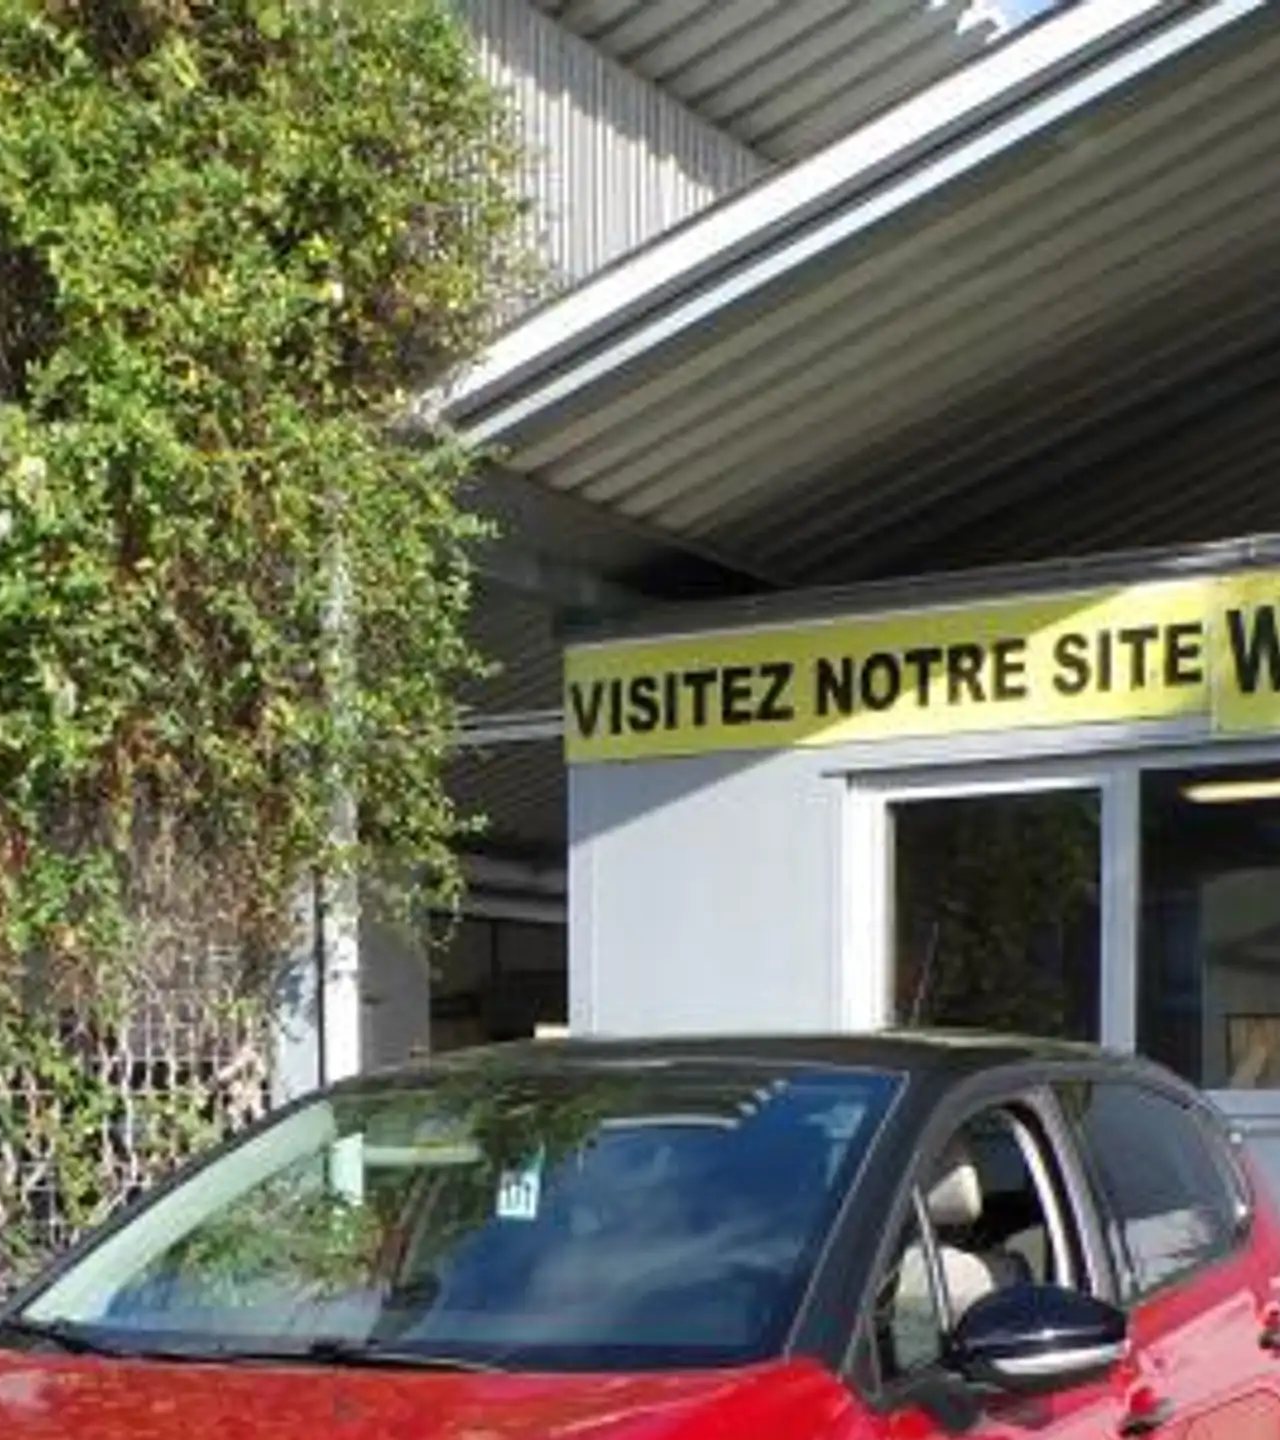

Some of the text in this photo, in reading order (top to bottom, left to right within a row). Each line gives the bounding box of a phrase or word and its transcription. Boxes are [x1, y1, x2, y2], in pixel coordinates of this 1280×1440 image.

[570, 622, 1204, 738] VISITEZ NOTRE SITE
